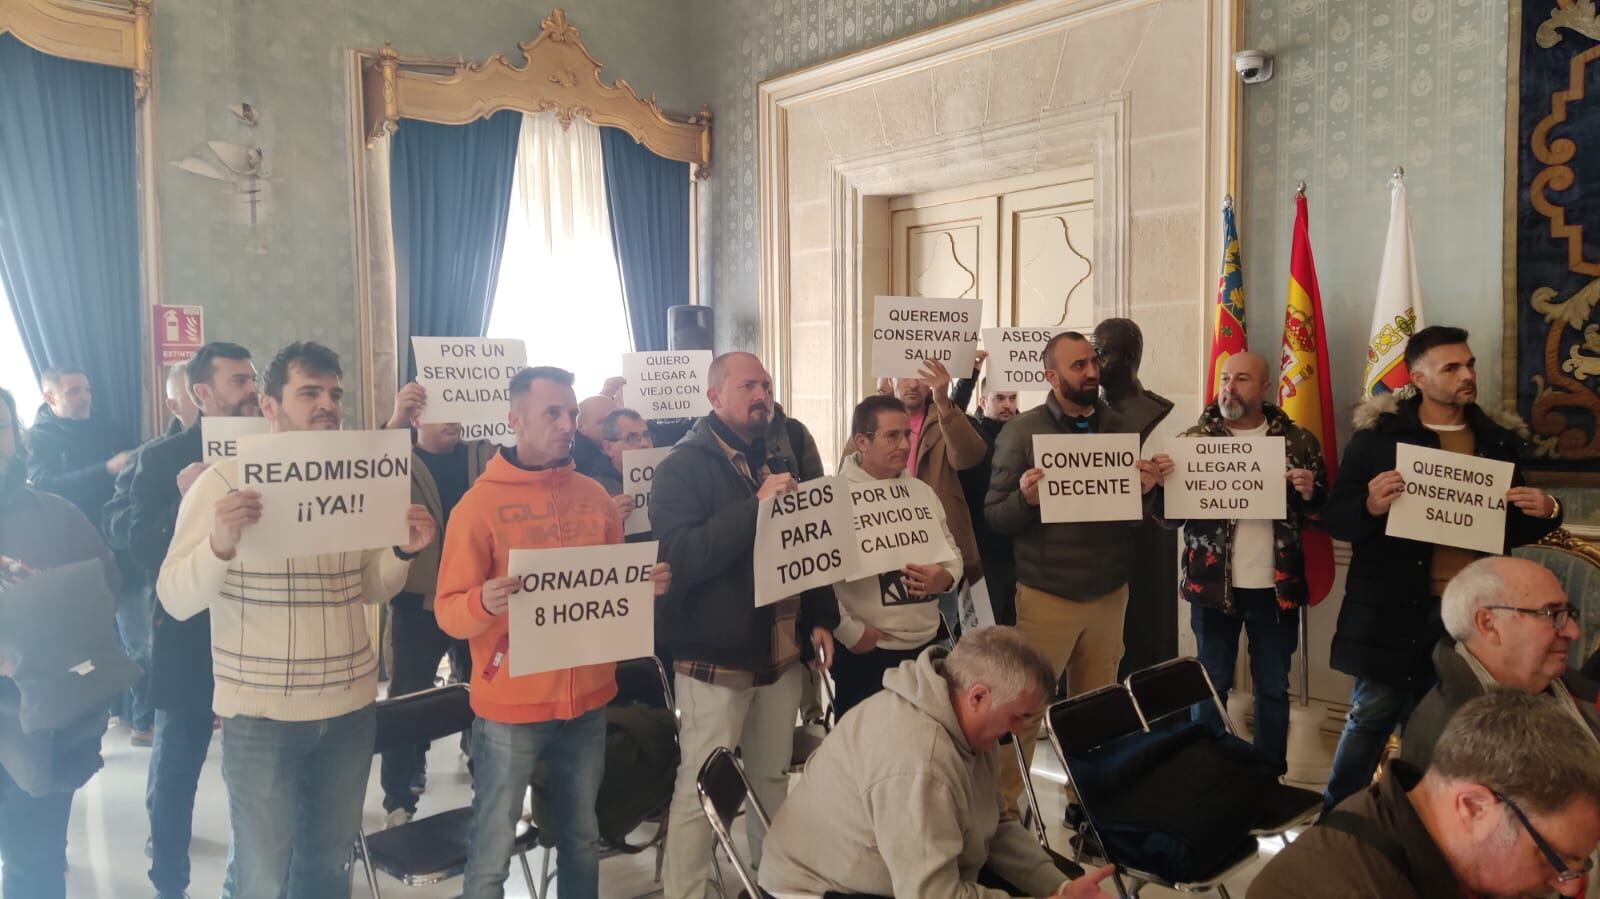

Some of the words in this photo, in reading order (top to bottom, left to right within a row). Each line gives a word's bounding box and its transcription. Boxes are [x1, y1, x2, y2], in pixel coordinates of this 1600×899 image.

[889, 310, 969, 323] QUEREMOS
[874, 328, 960, 342] CONSERVAR
[964, 331, 978, 342] LA
[1002, 330, 1052, 342] ASEOS
[440, 344, 476, 357] POR
[482, 344, 504, 356] UN
[904, 348, 952, 360] SALUD
[646, 355, 690, 366] QUIERO
[423, 366, 500, 380] SERVICIO
[641, 371, 686, 381] LLEGAR
[690, 370, 696, 379] A
[1004, 370, 1045, 382] TODO
[640, 386, 672, 396] VIEJO
[676, 384, 700, 394] CON
[652, 400, 690, 411] SALUD
[1196, 443, 1252, 454] QUIERO
[1042, 452, 1134, 468] CONVENIO
[244, 453, 408, 484] READMISIÓN
[1188, 462, 1246, 473] LLEGAR
[1251, 462, 1261, 472] A
[1413, 461, 1494, 487] QUEREMOS
[1048, 478, 1130, 496] DECENTE
[1185, 480, 1228, 491] VIEJO
[1232, 480, 1264, 491] CON
[770, 484, 834, 518] ASEOS
[851, 488, 887, 506] POR
[891, 484, 910, 500] UN
[1401, 480, 1484, 508] ONSERVAR
[1488, 497, 1504, 511] LA
[298, 494, 364, 522] ¡¡YA!!
[1200, 498, 1249, 510] SALUD
[915, 506, 932, 520] DE
[1426, 508, 1473, 526] SALUD
[781, 520, 832, 550] PARA
[861, 530, 929, 554] CALIDAD
[625, 564, 653, 583] DE
[777, 549, 842, 584] TODOS
[535, 606, 546, 626] 8
[553, 598, 629, 624] HORAS
